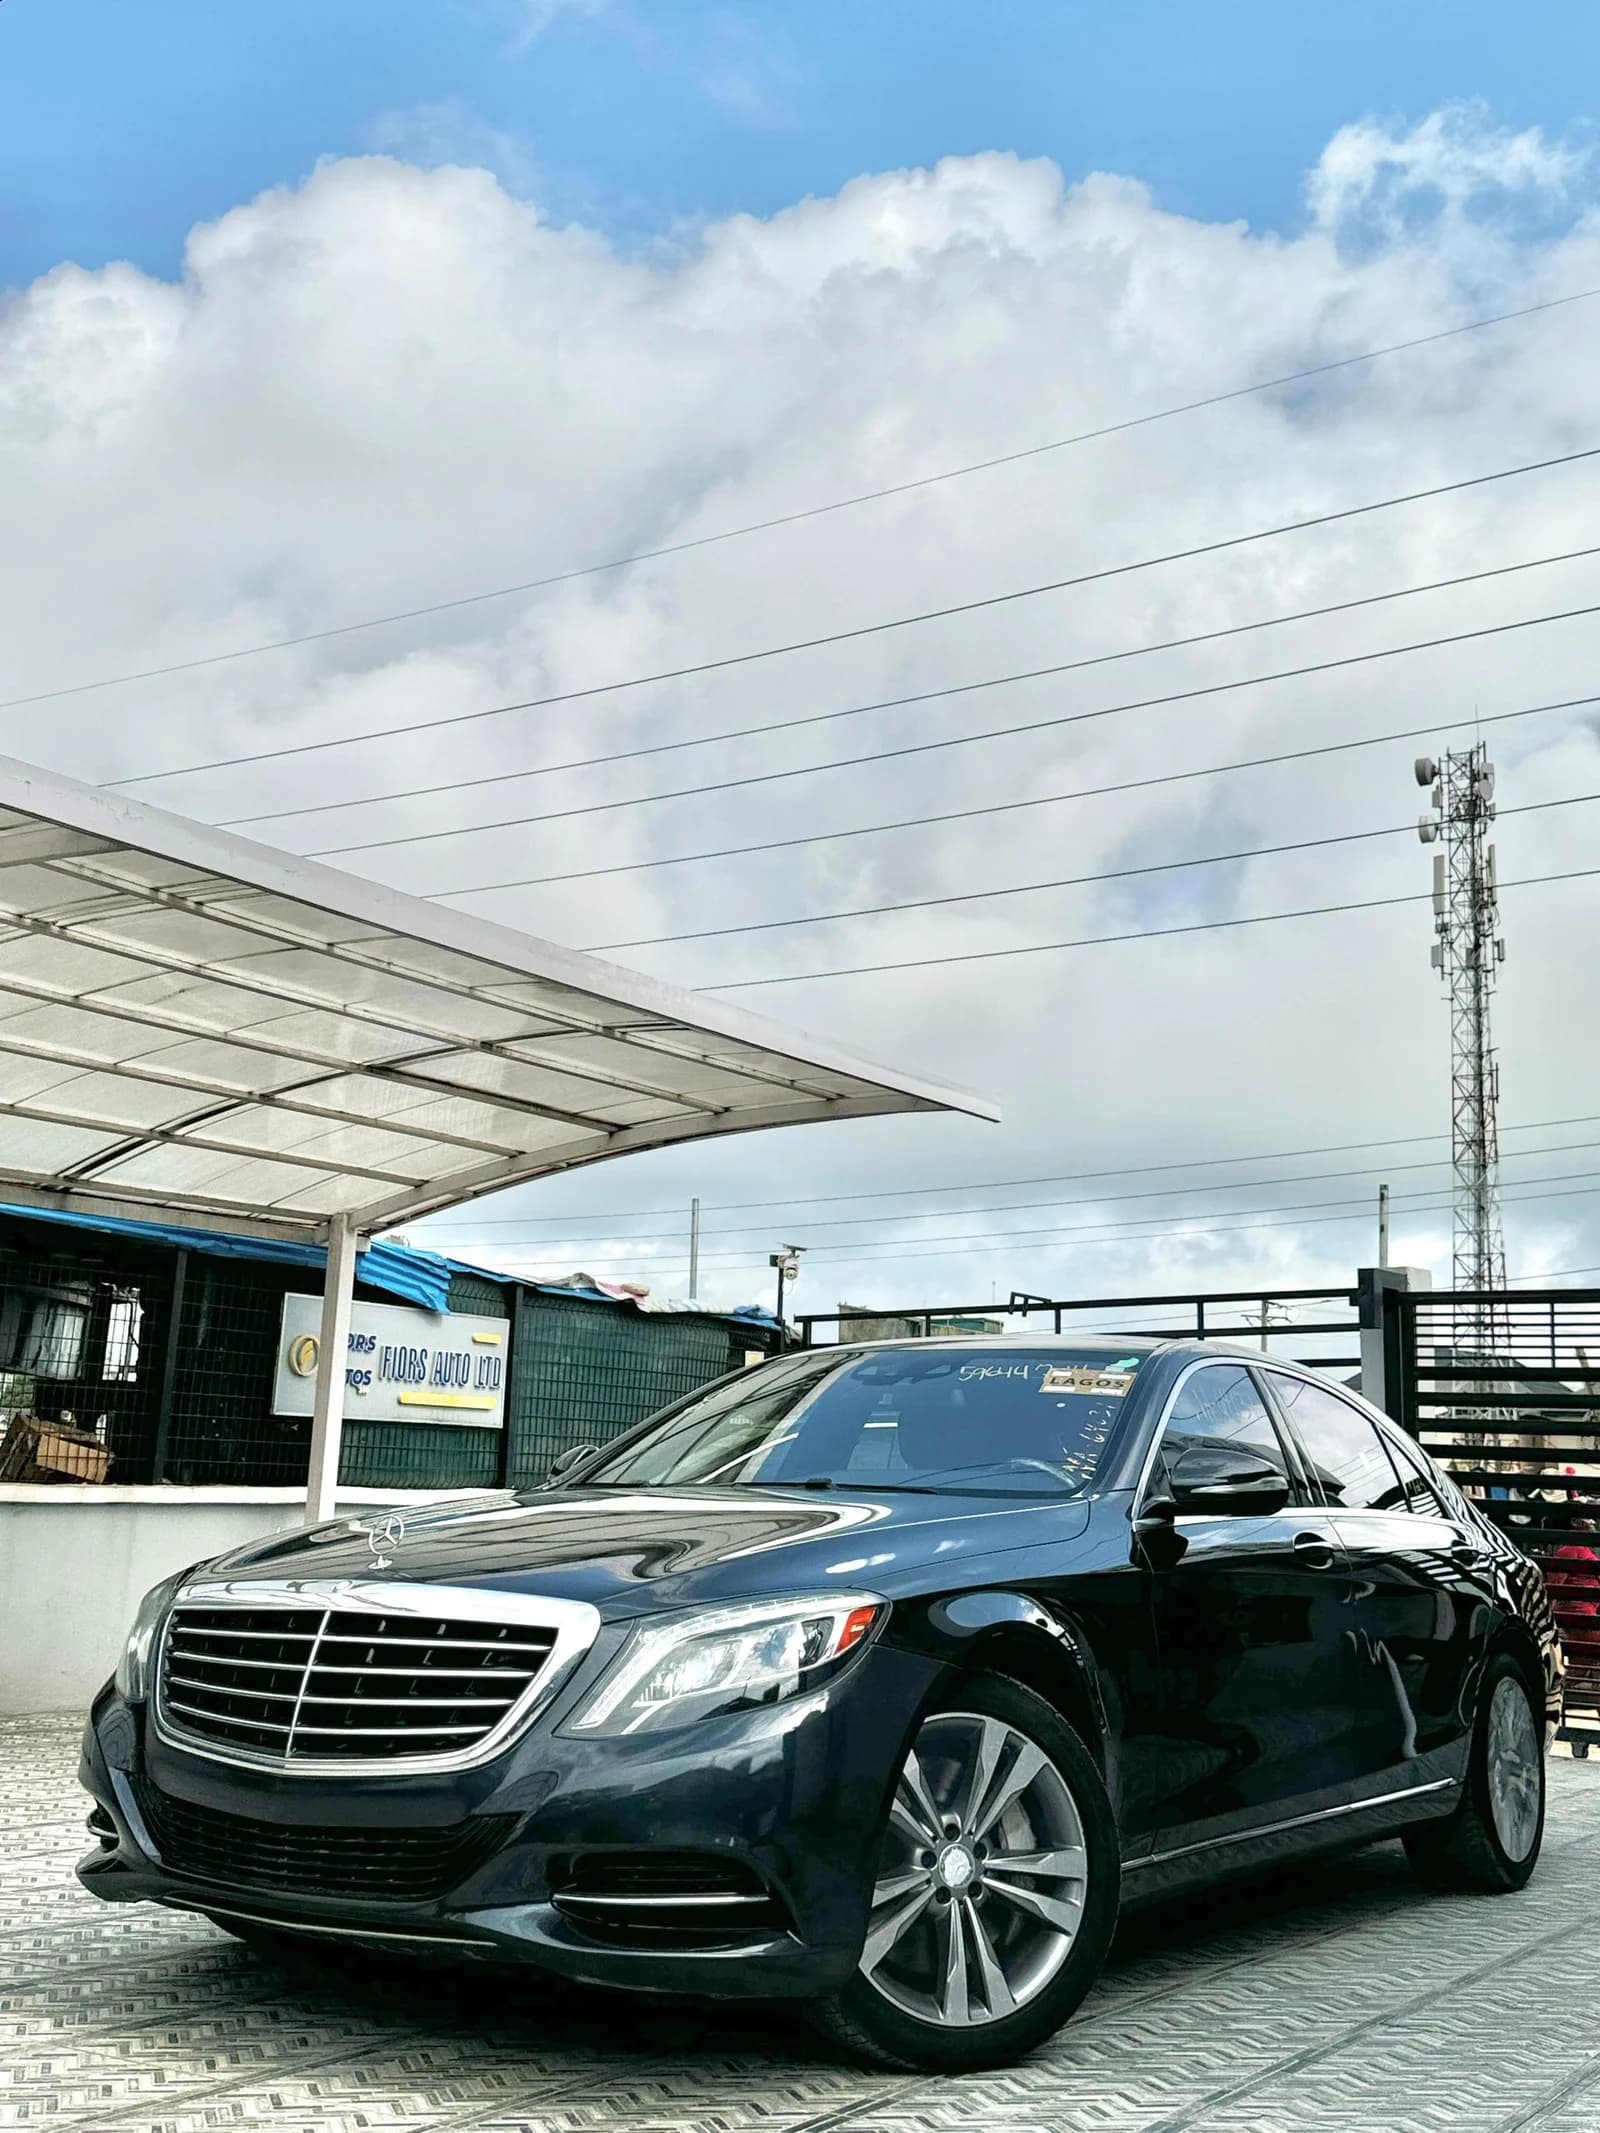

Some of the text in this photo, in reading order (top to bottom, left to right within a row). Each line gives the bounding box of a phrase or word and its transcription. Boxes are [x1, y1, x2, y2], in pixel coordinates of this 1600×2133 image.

[348, 1333, 377, 1351] ORS
[382, 1346, 502, 1387] FIORS AUTO LTD
[345, 1368, 372, 1386] TOS
[1049, 1376, 1125, 1389] LAGOS
